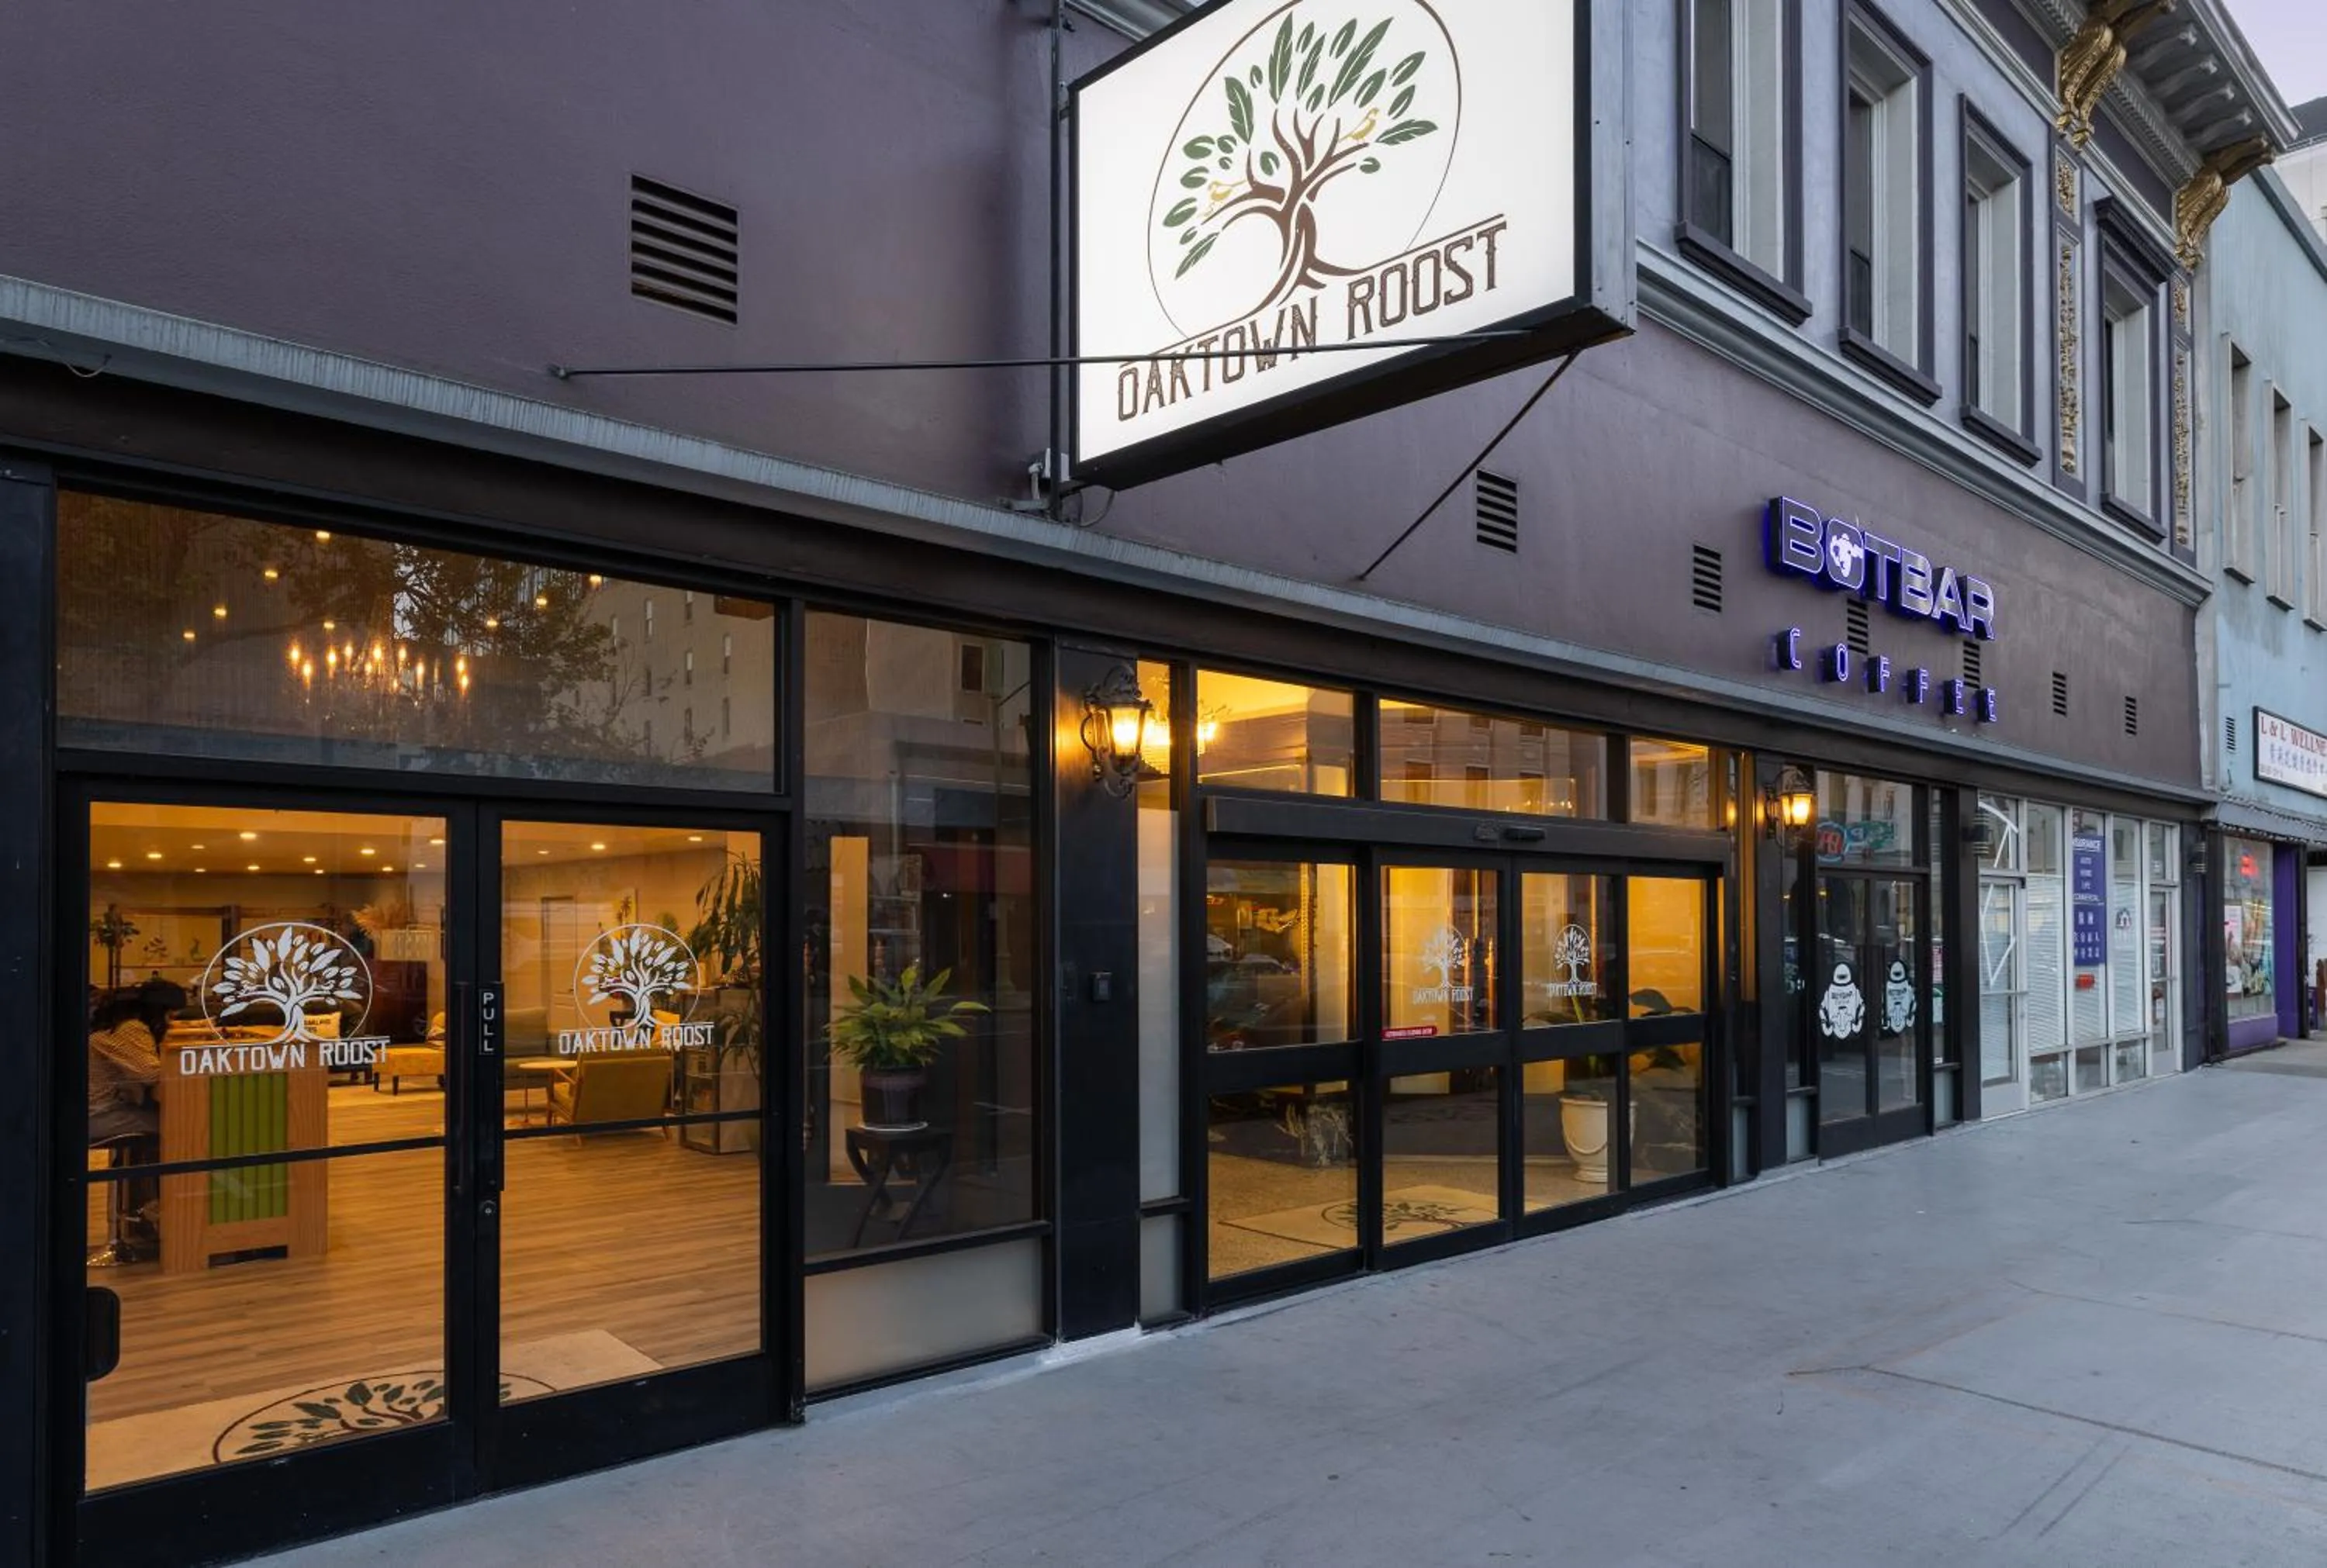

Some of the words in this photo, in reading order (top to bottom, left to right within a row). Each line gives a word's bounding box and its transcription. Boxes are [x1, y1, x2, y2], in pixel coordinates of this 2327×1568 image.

[1118, 295, 1318, 422] OAKTOWN
[1347, 222, 1506, 340] ROOST
[1773, 496, 1995, 640] BOTBAR
[1783, 627, 1997, 723] COFFEE
[181, 1045, 305, 1076] OAKTOWN
[319, 1040, 389, 1066] ROOST
[483, 993, 495, 1052] PULL
[558, 1028, 651, 1055] OAKTOWN
[662, 1024, 714, 1050] ROOST
